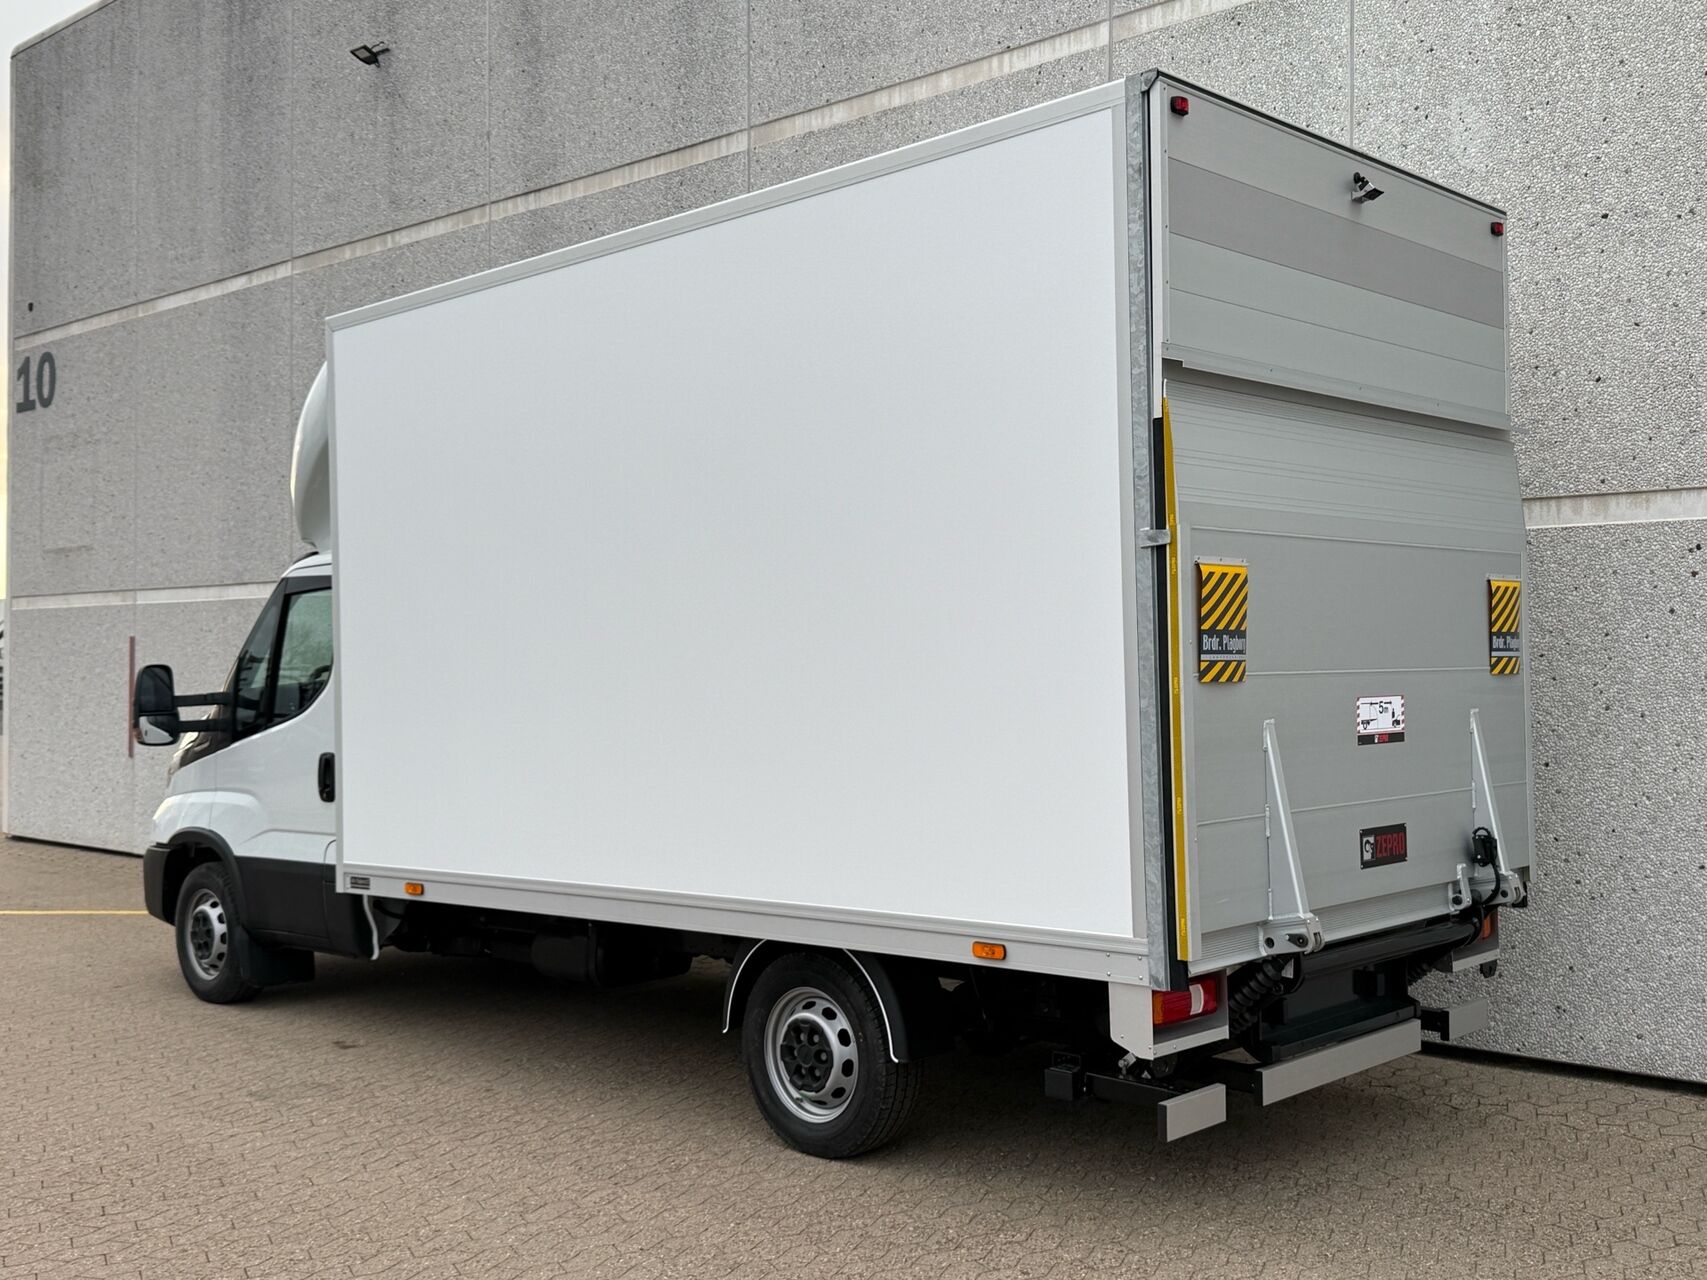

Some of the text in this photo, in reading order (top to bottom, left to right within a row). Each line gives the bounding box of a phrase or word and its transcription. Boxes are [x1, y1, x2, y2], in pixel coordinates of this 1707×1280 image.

[16, 352, 56, 413] 10
[1203, 635, 1221, 650] Brdr.
[1376, 832, 1405, 858] ZEPRO
